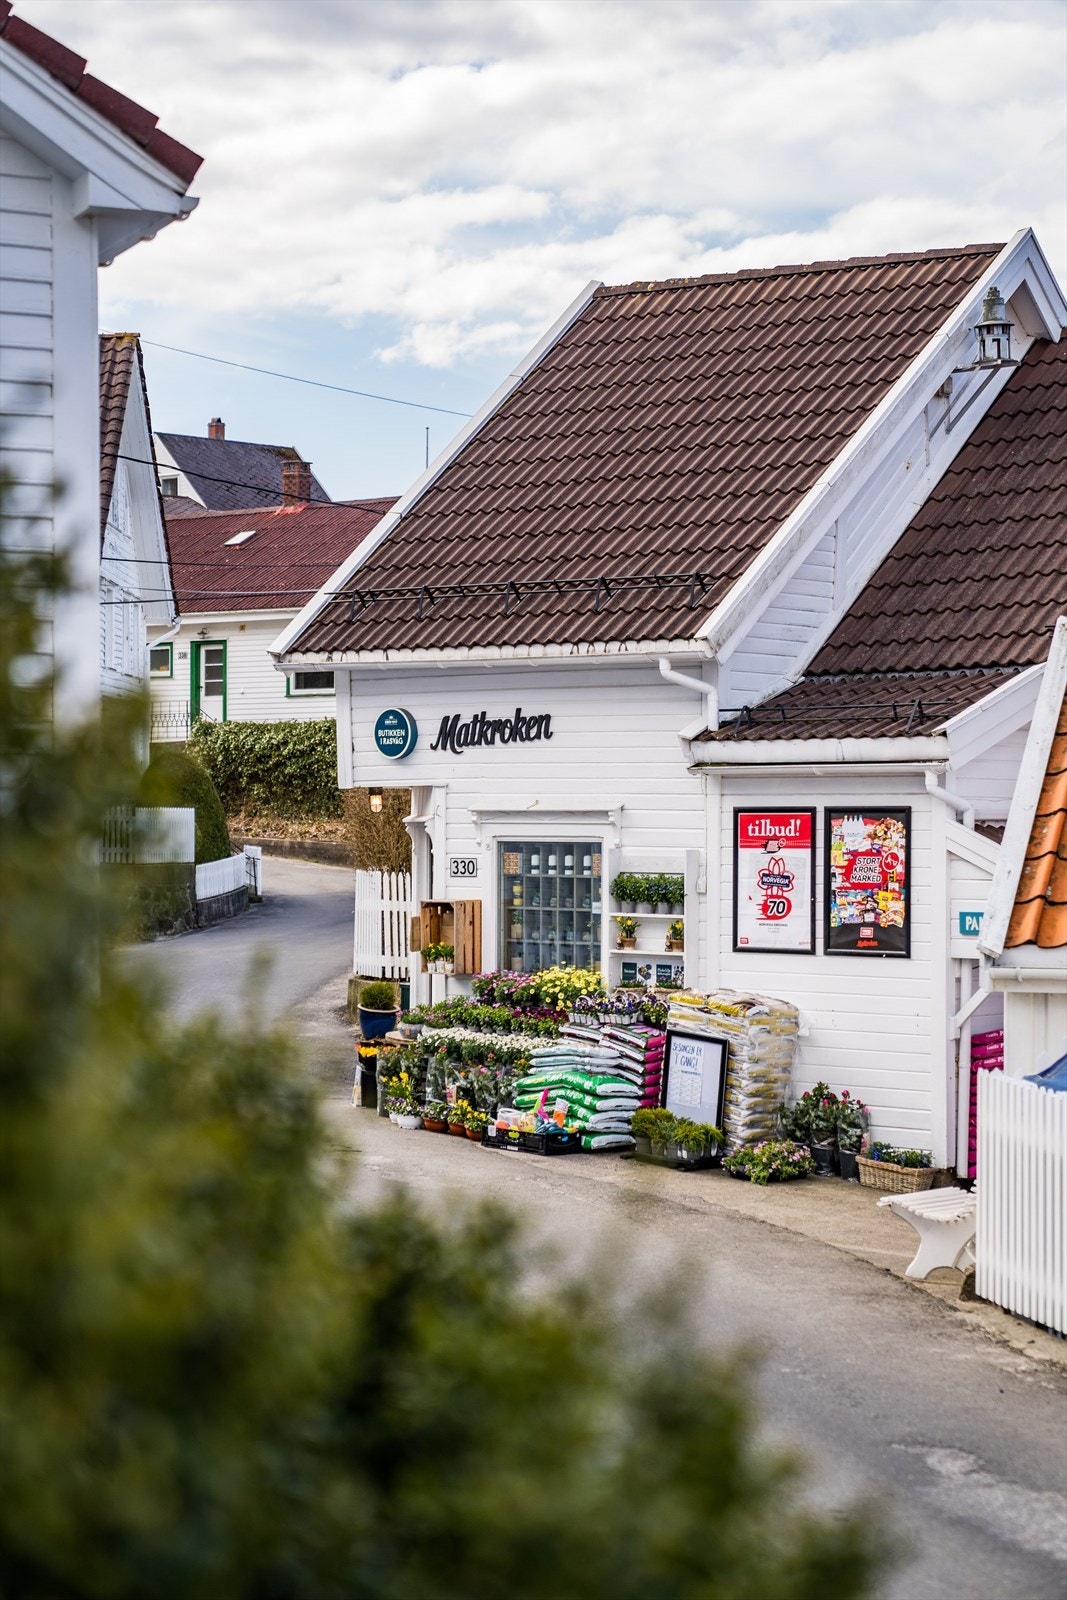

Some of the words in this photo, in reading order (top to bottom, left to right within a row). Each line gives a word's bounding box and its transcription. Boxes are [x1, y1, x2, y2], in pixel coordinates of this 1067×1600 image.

[378, 729, 405, 737] BUTIKKEN
[430, 707, 554, 755] Matkroken
[747, 819, 800, 837] tilbud!
[857, 857, 881, 866] STORT
[452, 860, 475, 875] 330
[853, 865, 881, 874] KRONE-
[762, 876, 790, 885] NORVEGIA
[850, 874, 882, 883] MARKED
[768, 900, 786, 914] 70
